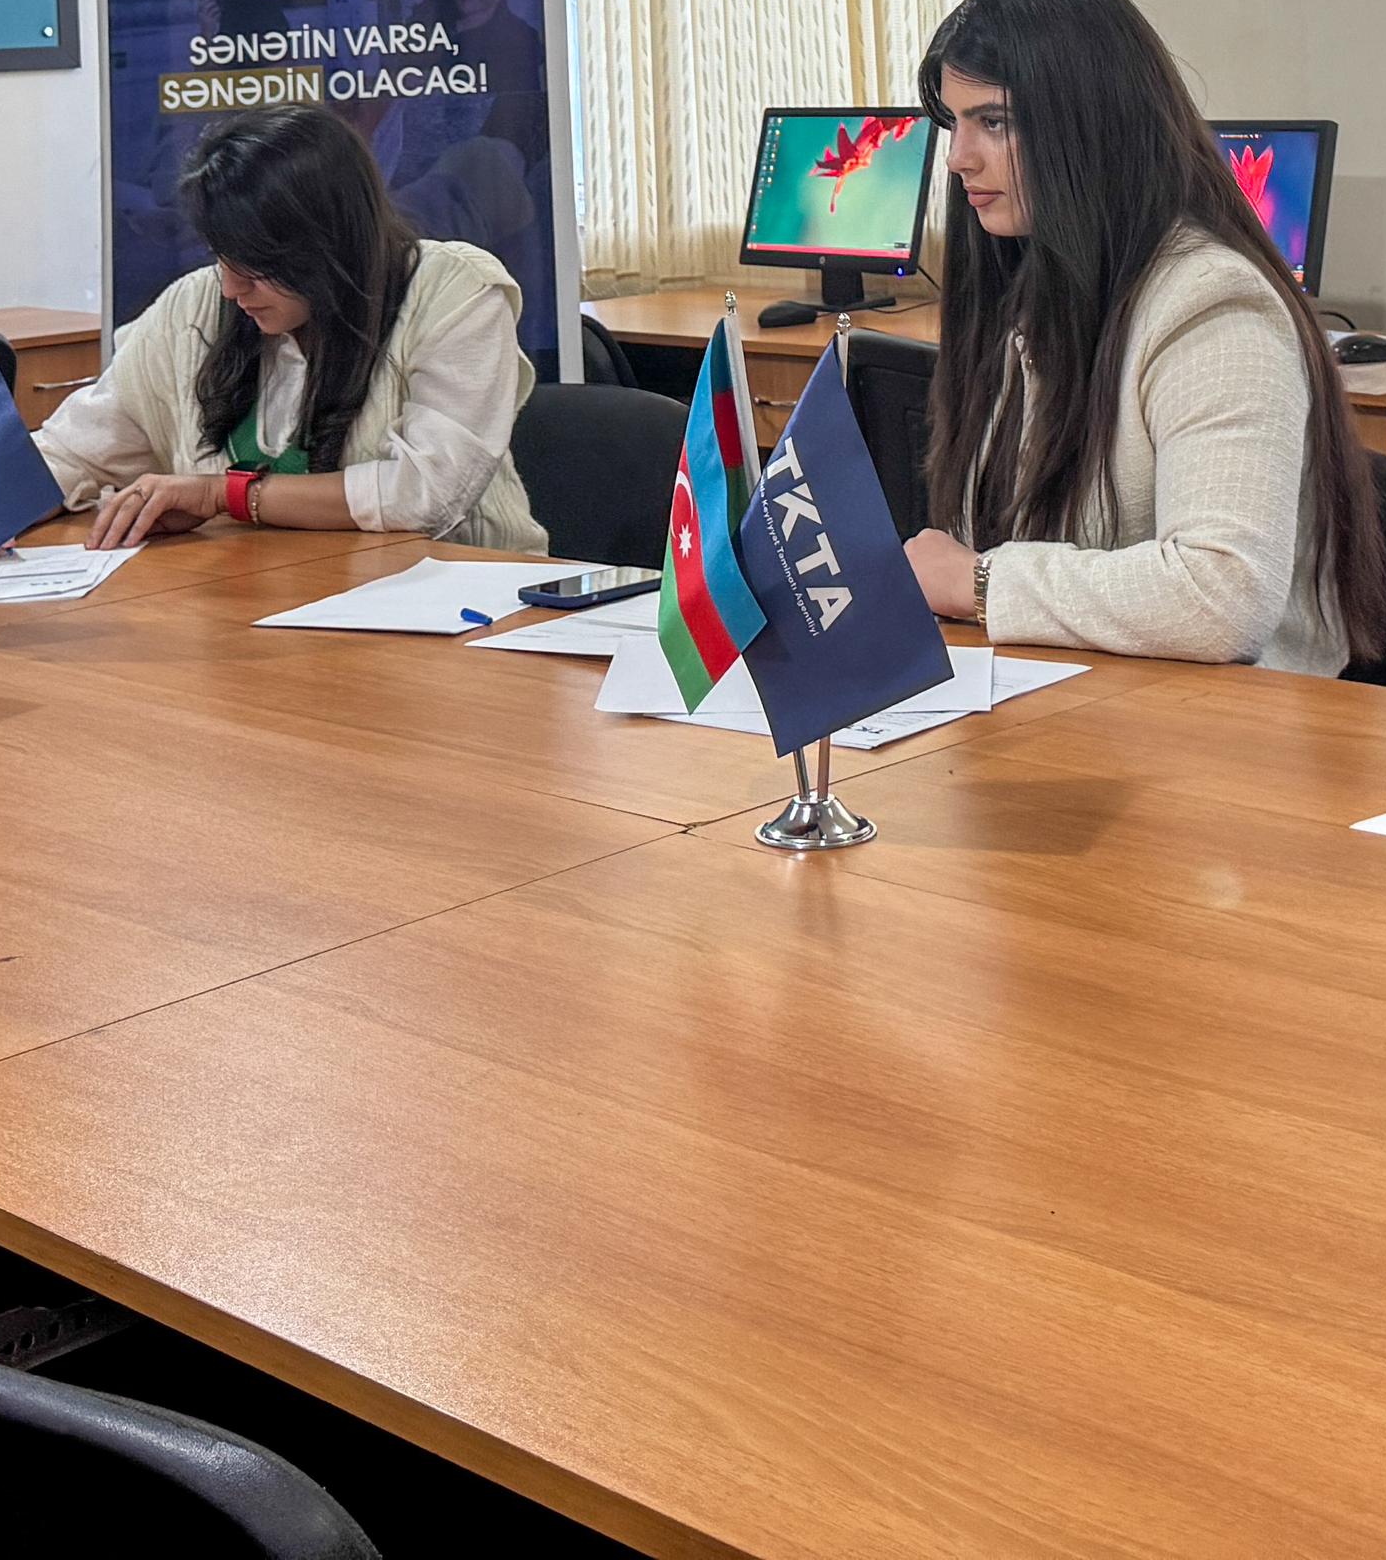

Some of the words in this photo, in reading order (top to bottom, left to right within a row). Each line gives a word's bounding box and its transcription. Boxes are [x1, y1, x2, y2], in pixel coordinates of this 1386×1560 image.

[190, 24, 336, 66] SƏNƏTİN
[343, 22, 459, 56] VARSA,
[164, 68, 320, 110] SƏNƏDİN
[328, 63, 488, 101] OLACAQ!
[767, 436, 853, 632] TKTA
